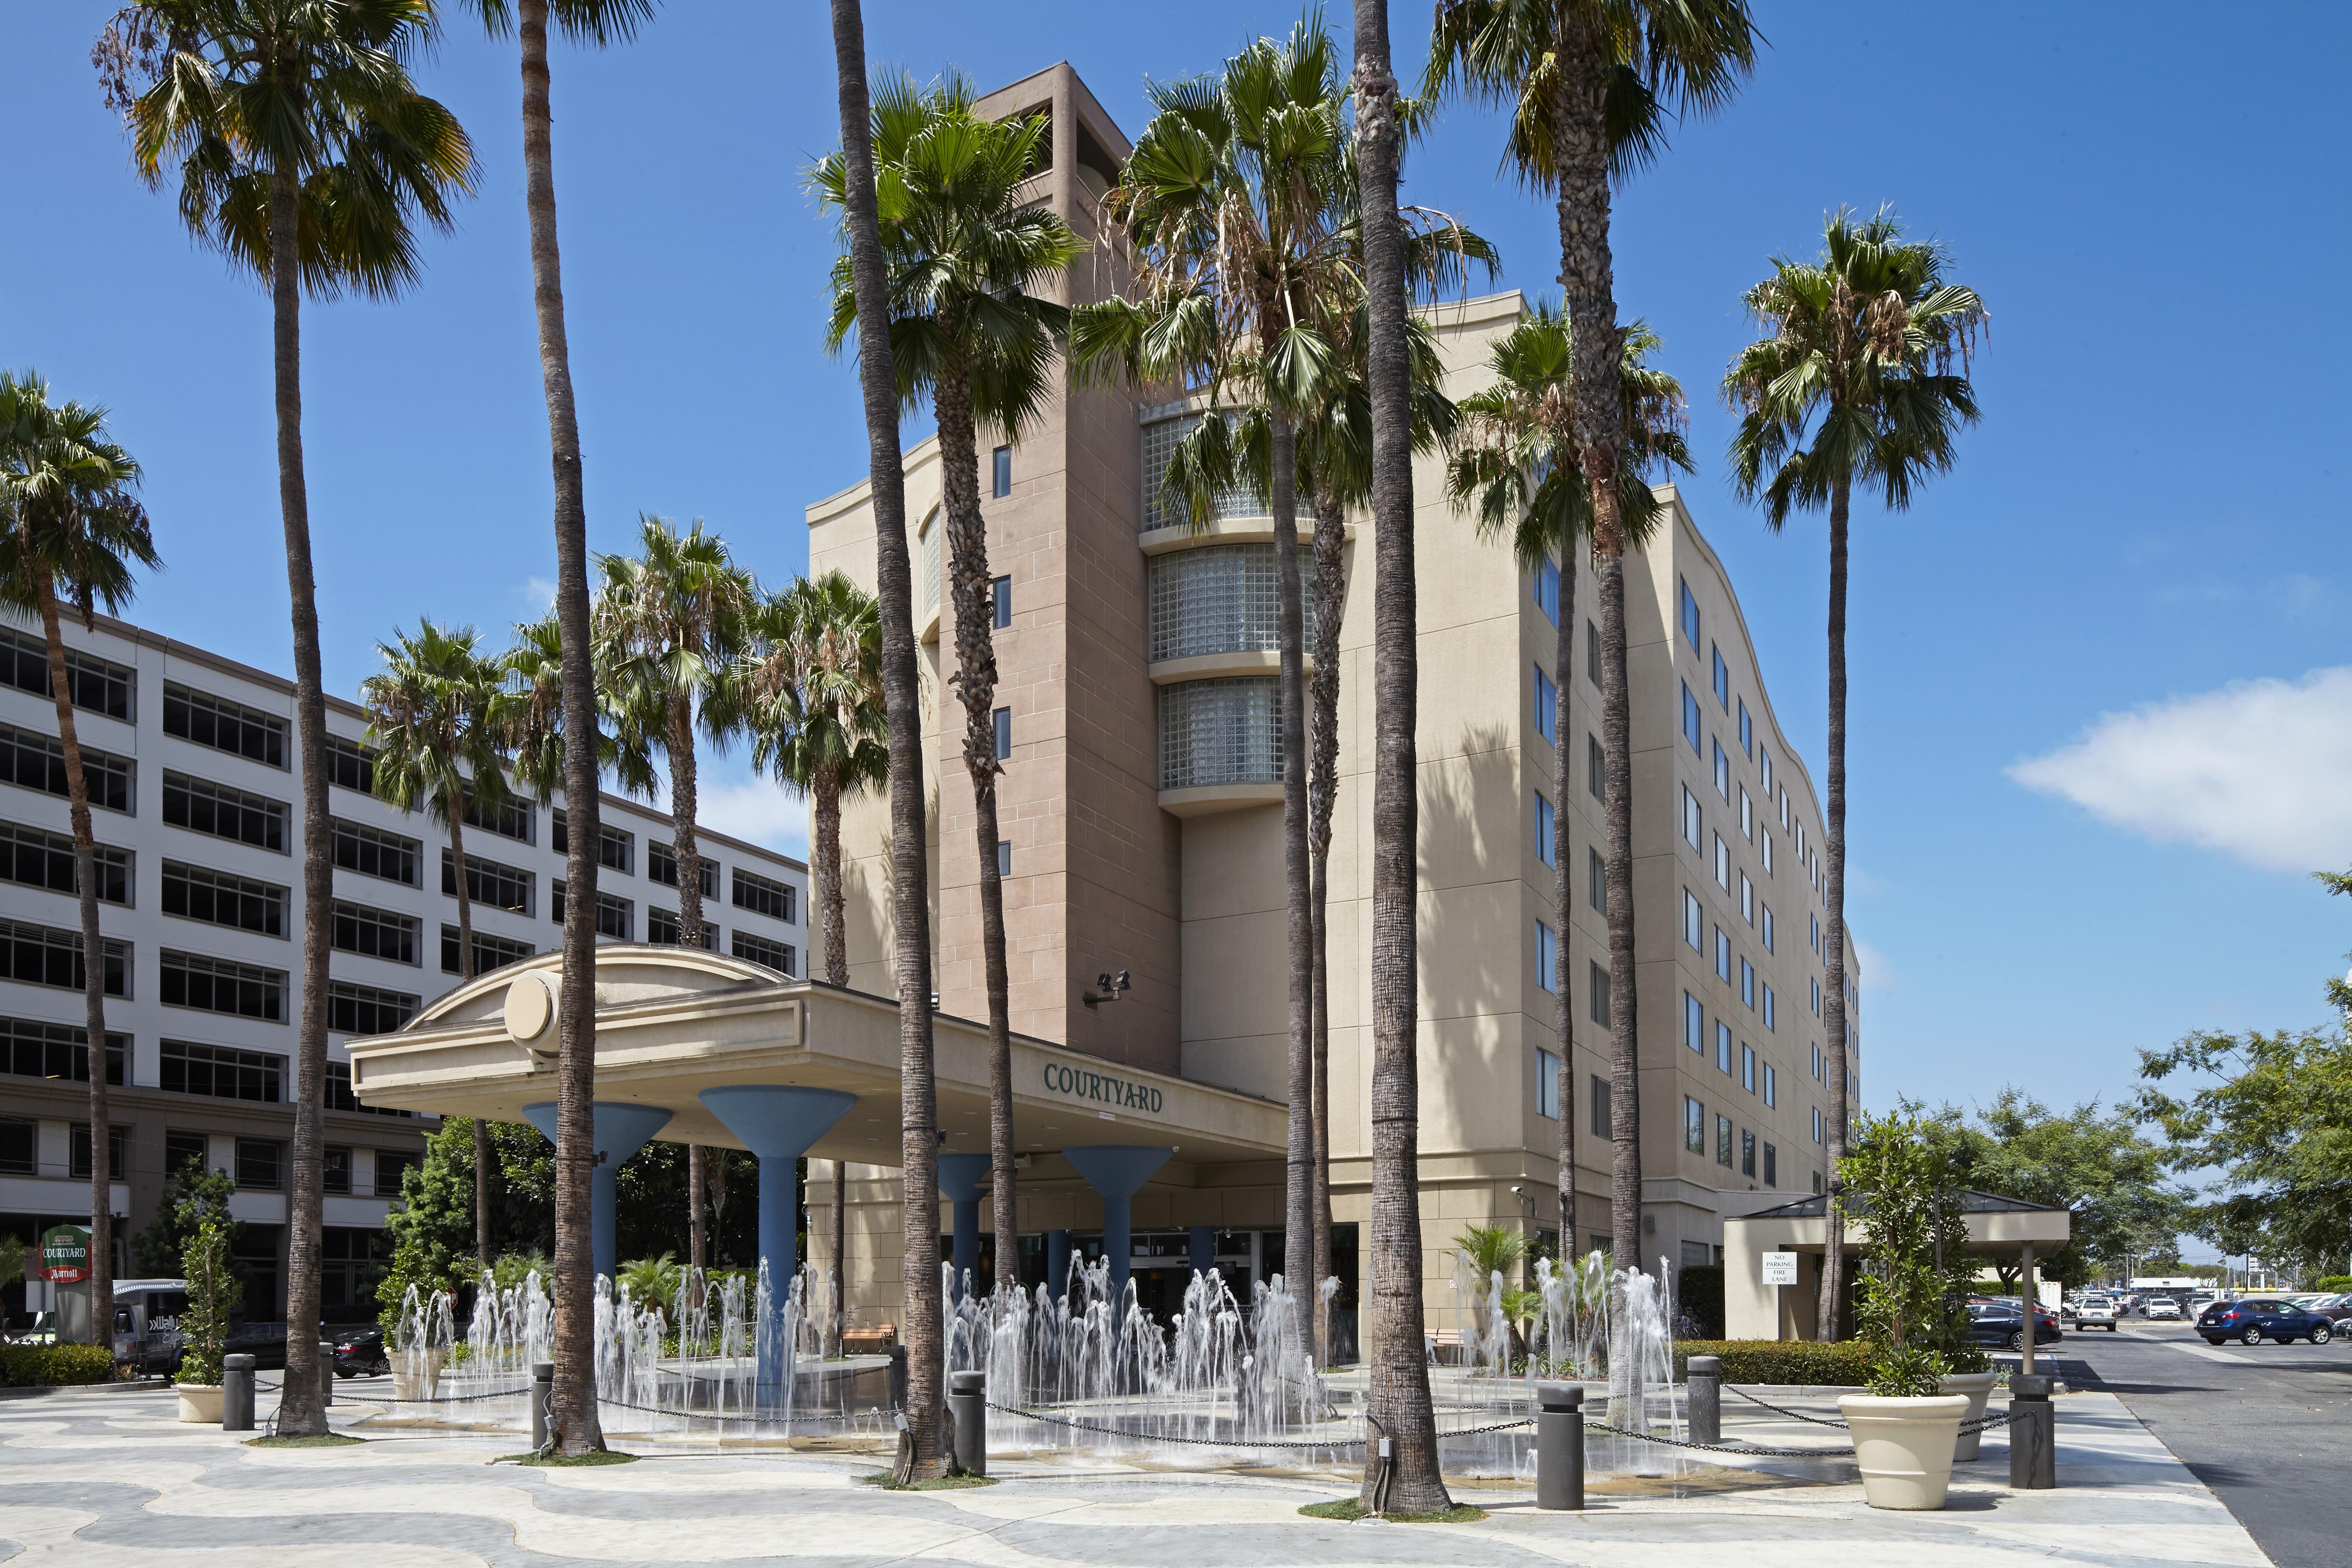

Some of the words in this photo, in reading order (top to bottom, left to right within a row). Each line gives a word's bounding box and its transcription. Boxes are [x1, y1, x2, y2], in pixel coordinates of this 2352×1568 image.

[1044, 1063, 1162, 1113] COURTYARD
[43, 1248, 86, 1258] COURTYARD
[51, 1269, 77, 1279] Marriott
